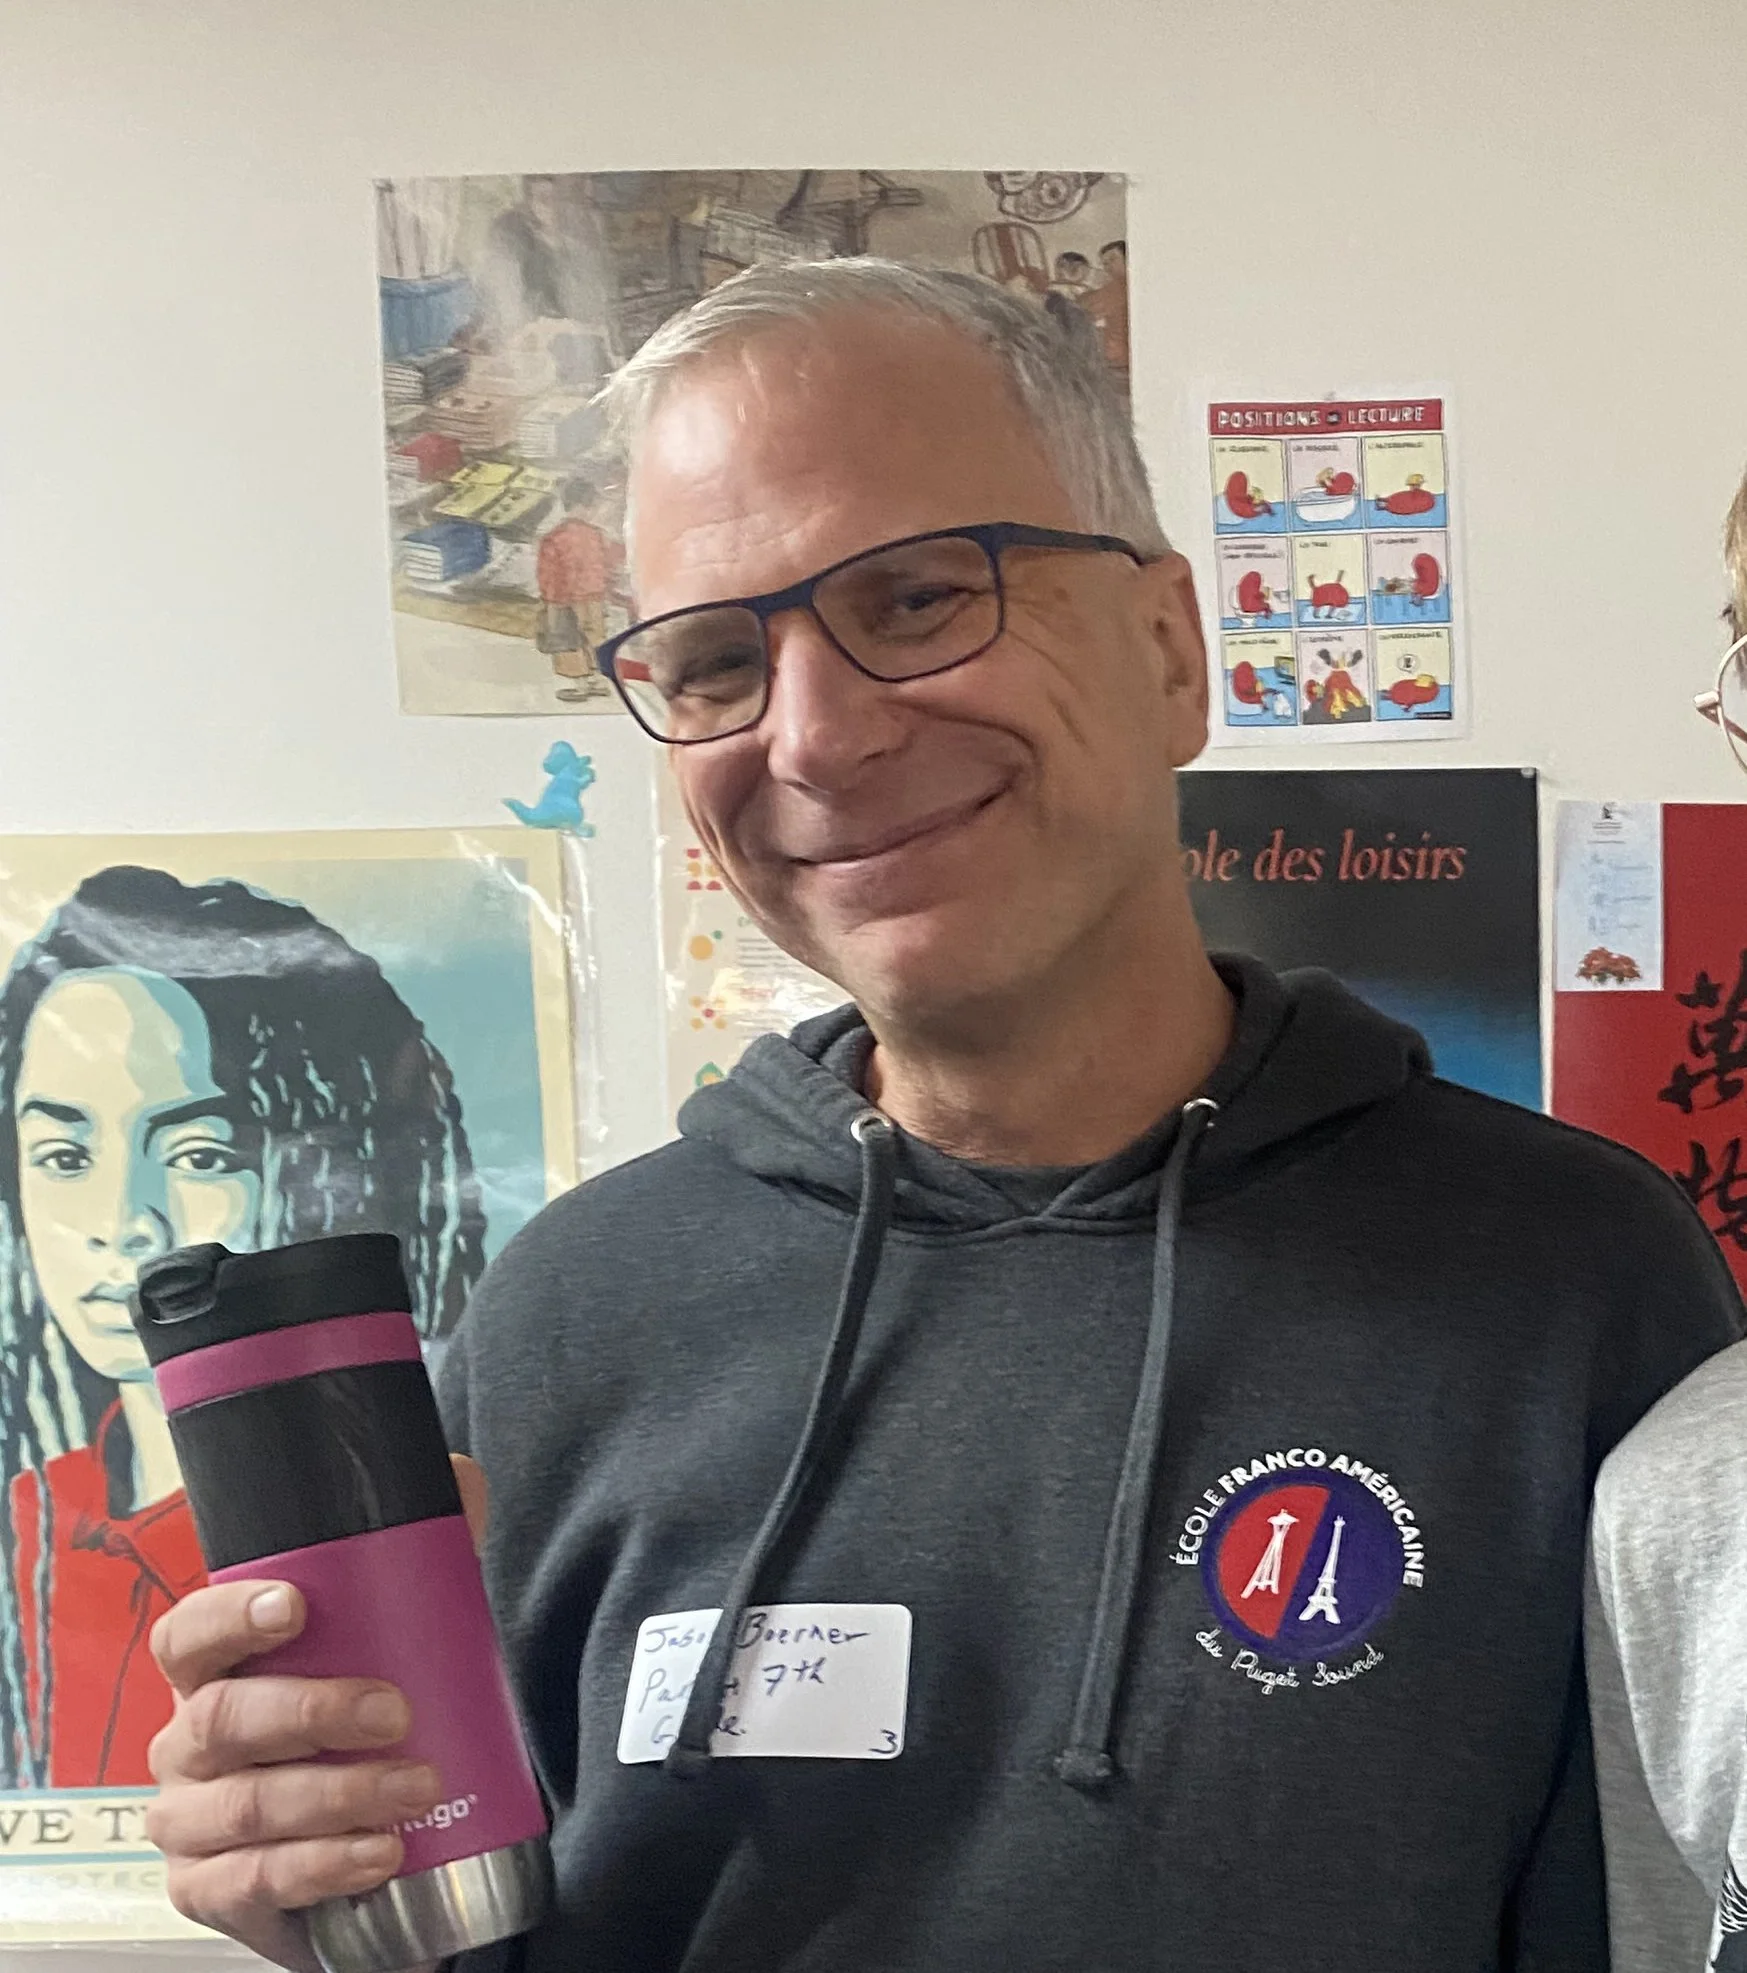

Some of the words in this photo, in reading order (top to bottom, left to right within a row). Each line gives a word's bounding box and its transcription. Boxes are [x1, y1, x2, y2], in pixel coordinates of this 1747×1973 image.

[1217, 409, 1322, 429] POSITIONS
[1347, 406, 1425, 425] LECTURE
[1183, 828, 1241, 882] ole
[1253, 827, 1325, 882] des
[1338, 828, 1467, 881] loisirs
[1169, 1488, 1227, 1565] ÉCOLE
[1218, 1448, 1327, 1494] FRANCO
[1329, 1454, 1424, 1588] AMÉRICAINE
[643, 1624, 706, 1654] Jaso
[761, 1656, 827, 1697] 7th
[1195, 1626, 1224, 1658] du
[1230, 1648, 1300, 1695] Puget
[1311, 1642, 1385, 1687] Sound
[95, 1805, 149, 1842] T
